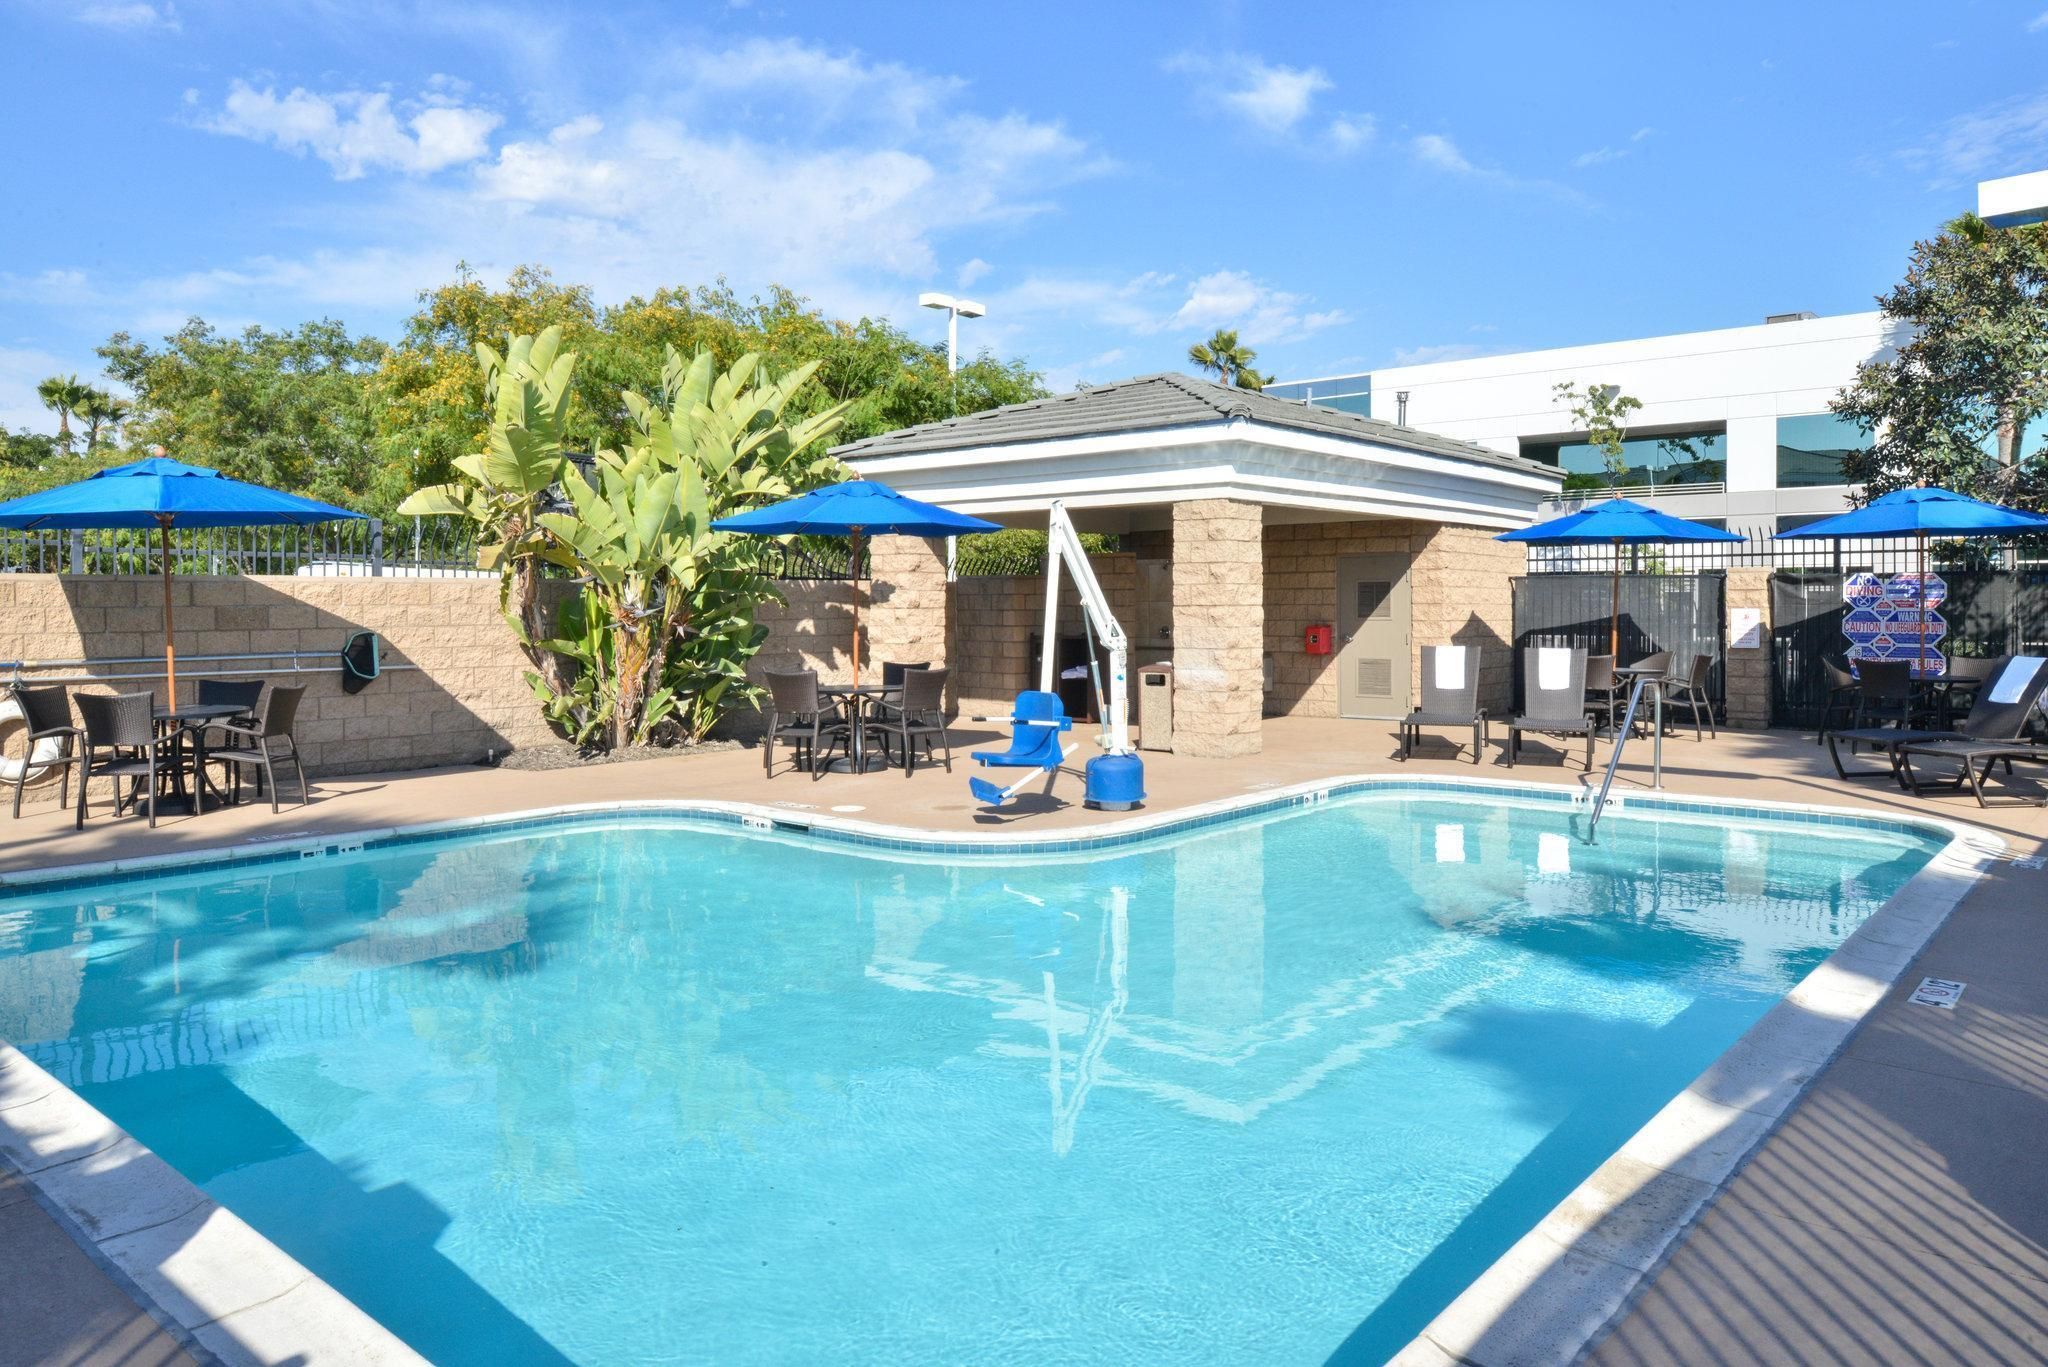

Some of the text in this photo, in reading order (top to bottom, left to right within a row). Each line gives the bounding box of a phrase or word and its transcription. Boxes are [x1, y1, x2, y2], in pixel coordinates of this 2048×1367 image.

[1857, 575, 1873, 585] NO
[1846, 586, 1883, 596] DIVING
[1898, 611, 1933, 621] WARNNG
[1844, 622, 1881, 631] CAUTION
[1885, 622, 1892, 632] NO
[1894, 622, 1920, 632] LIFEGUARD
[1931, 622, 1945, 632] DUTY
